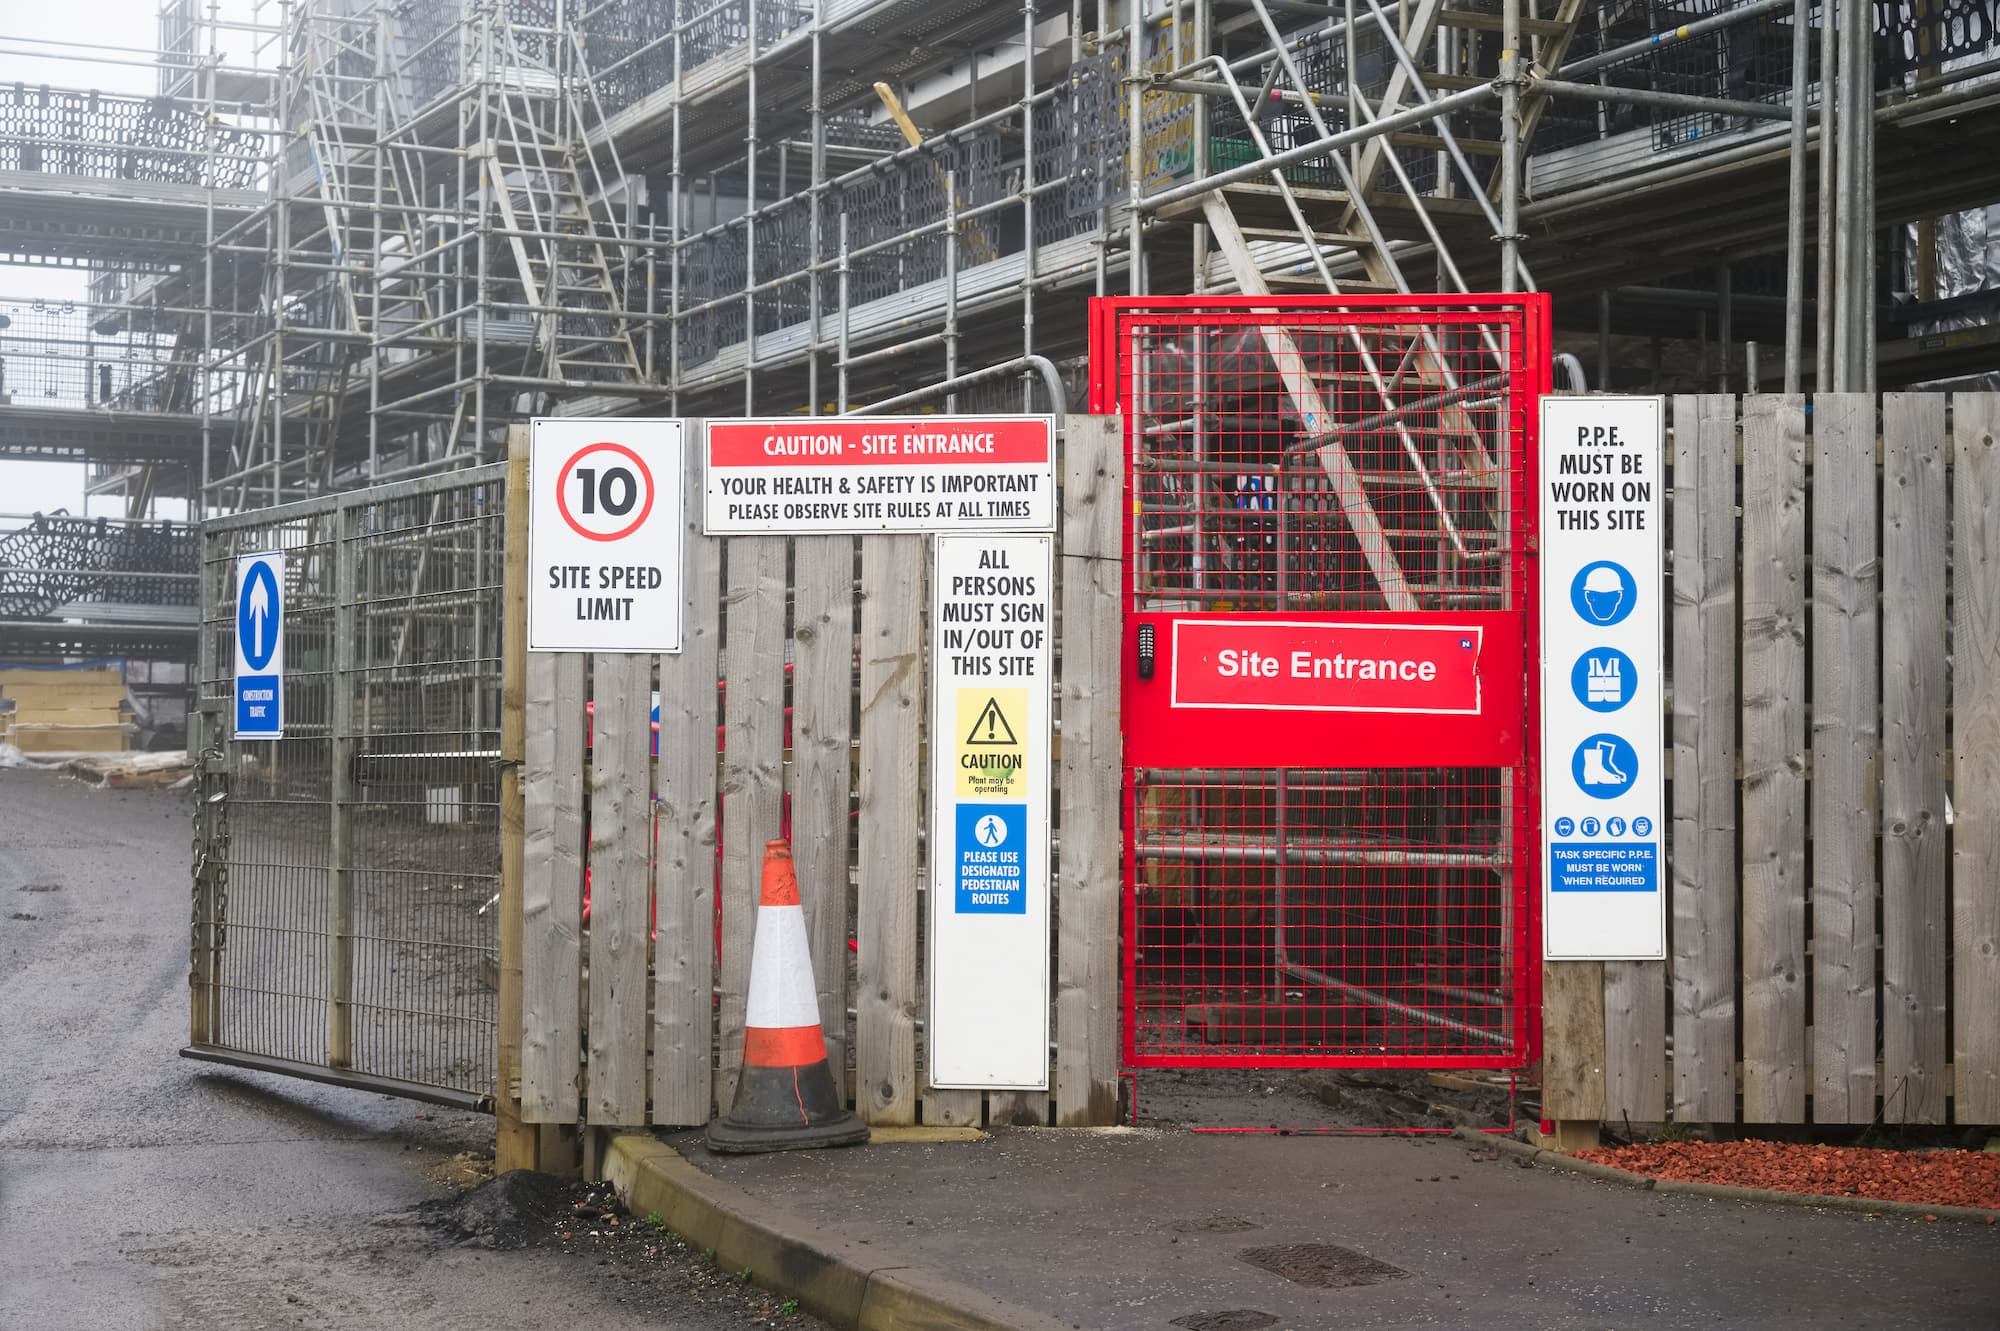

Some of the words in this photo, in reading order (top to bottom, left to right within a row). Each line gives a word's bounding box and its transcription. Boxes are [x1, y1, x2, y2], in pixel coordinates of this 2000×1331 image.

[763, 435, 842, 456] CAUTION
[862, 433, 896, 454] SITE
[903, 432, 995, 454] ENTRANCE
[1578, 426, 1625, 447] P.P.E.
[1559, 454, 1614, 475] MUST
[1621, 454, 1643, 475] BE
[576, 467, 637, 516] 10
[721, 477, 767, 496] YOUR
[773, 476, 833, 495] HEALTH
[839, 477, 851, 495] &
[857, 475, 916, 494] SAFETY
[921, 475, 935, 493] IS
[942, 474, 1039, 493] IMPORTANT
[1551, 482, 1614, 503] WORN
[1622, 482, 1651, 503] ON
[728, 503, 779, 520] PLEASE
[784, 502, 849, 519] OBSERVE
[853, 502, 883, 519] SITE
[887, 501, 931, 518] RULES
[936, 501, 952, 518] AT
[958, 501, 981, 517] ALL
[986, 500, 1031, 518] TIMES
[1557, 510, 1600, 531] THIS
[1607, 510, 1646, 531] SITE
[978, 549, 1010, 570] ALL
[549, 565, 591, 589] SITE
[599, 565, 662, 590] SPEED
[952, 576, 1035, 597] PERSONS
[576, 597, 634, 621] LIMIT
[943, 603, 995, 623] MUST
[1000, 603, 1045, 623] SIGN
[943, 628, 1015, 654] IN/OUT
[1020, 629, 1044, 650] OF
[951, 656, 992, 676] THIS
[999, 656, 1035, 677] SITE
[1217, 649, 1279, 678] Site
[1291, 651, 1437, 682] Entrance
[961, 754, 1022, 769] CAUTION
[968, 775, 986, 785] Plant
[988, 777, 1004, 787] may
[1005, 776, 1014, 785] be
[974, 785, 1009, 795] operating
[963, 851, 998, 863] PLEASE
[1000, 851, 1018, 863] USE
[1554, 850, 1580, 859] TASK
[1582, 850, 1626, 859] SPECIFIC
[1628, 850, 1653, 859] P.P.E.
[961, 865, 1020, 878] DESIGNATED
[1566, 863, 1594, 872] MUST
[1596, 863, 1609, 872] BE
[1612, 863, 1642, 872] WORN
[961, 879, 1020, 892] PEDESTRIAN
[1563, 876, 1593, 885] WHEN
[1595, 876, 1646, 885] REQUIRED
[972, 893, 1010, 905] ROUTES
